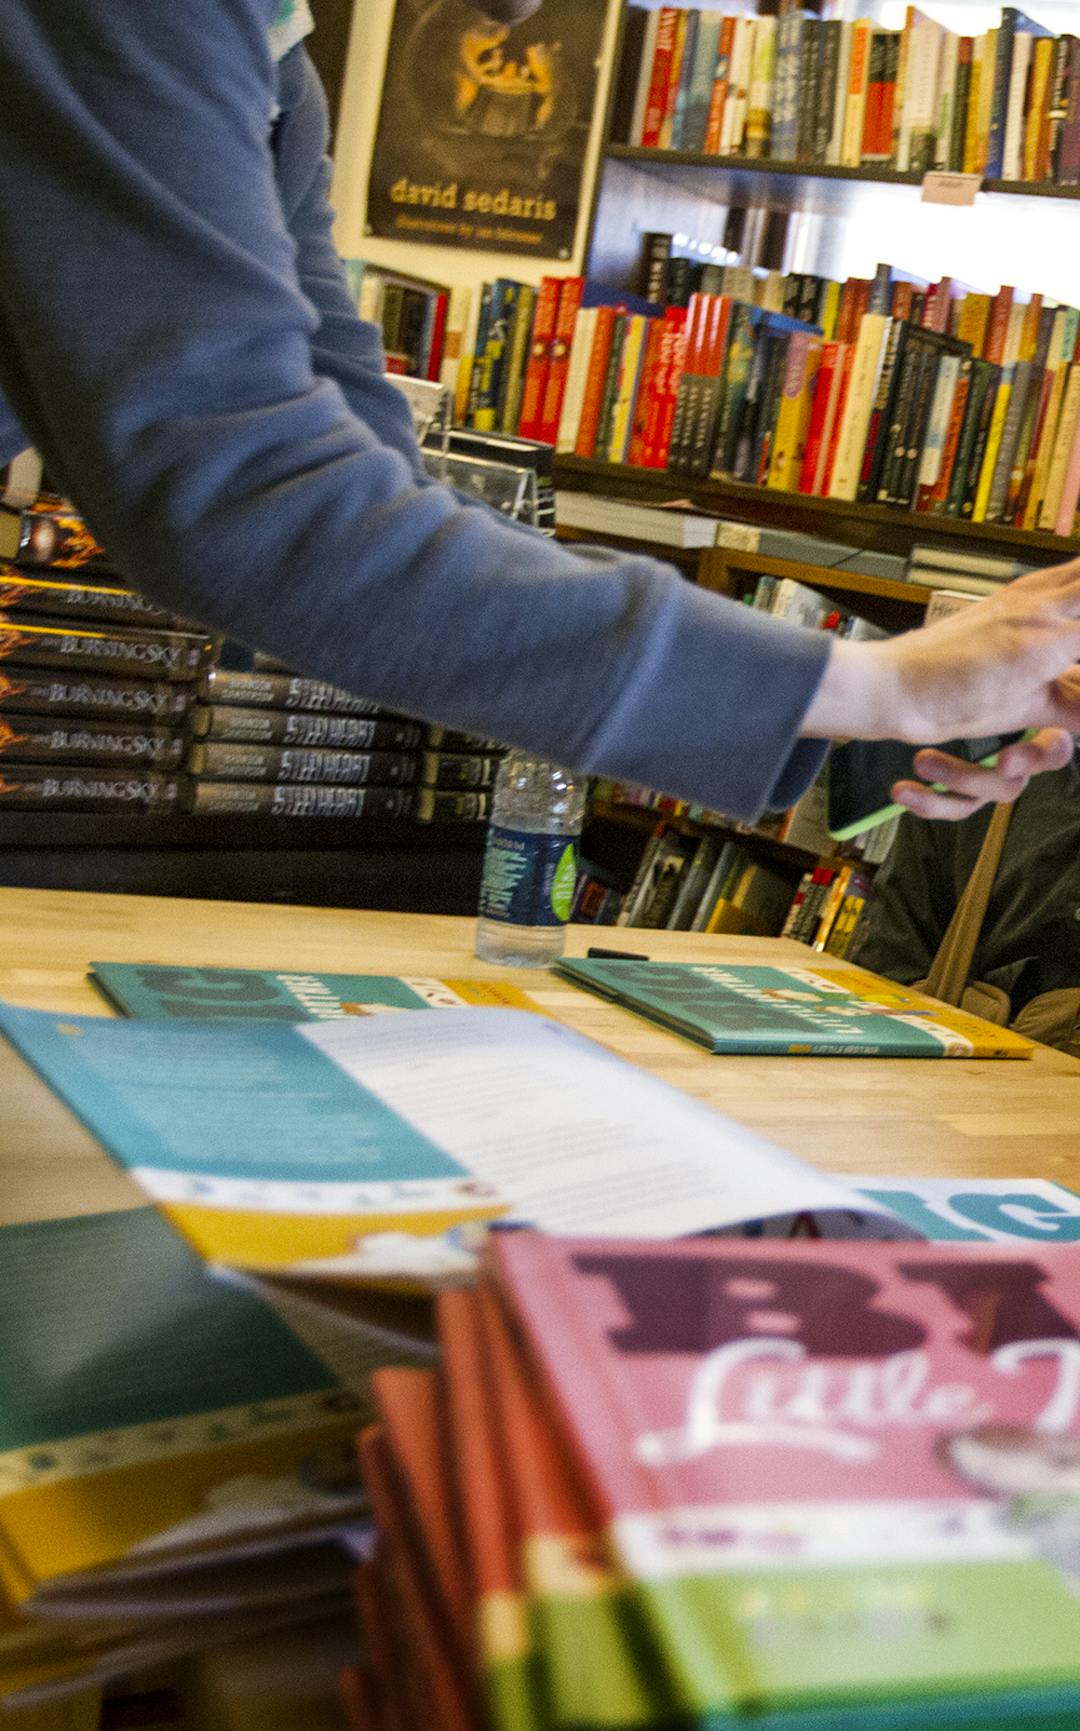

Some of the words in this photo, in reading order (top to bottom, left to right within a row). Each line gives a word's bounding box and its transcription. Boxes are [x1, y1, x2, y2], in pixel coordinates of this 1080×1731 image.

[390, 177, 458, 209] david
[464, 188, 557, 221] sedaris
[282, 714, 377, 748] STEELHEART
[277, 750, 372, 784] STEELHEART
[271, 785, 366, 817] STEELHEART
[592, 963, 829, 1032] BIG
